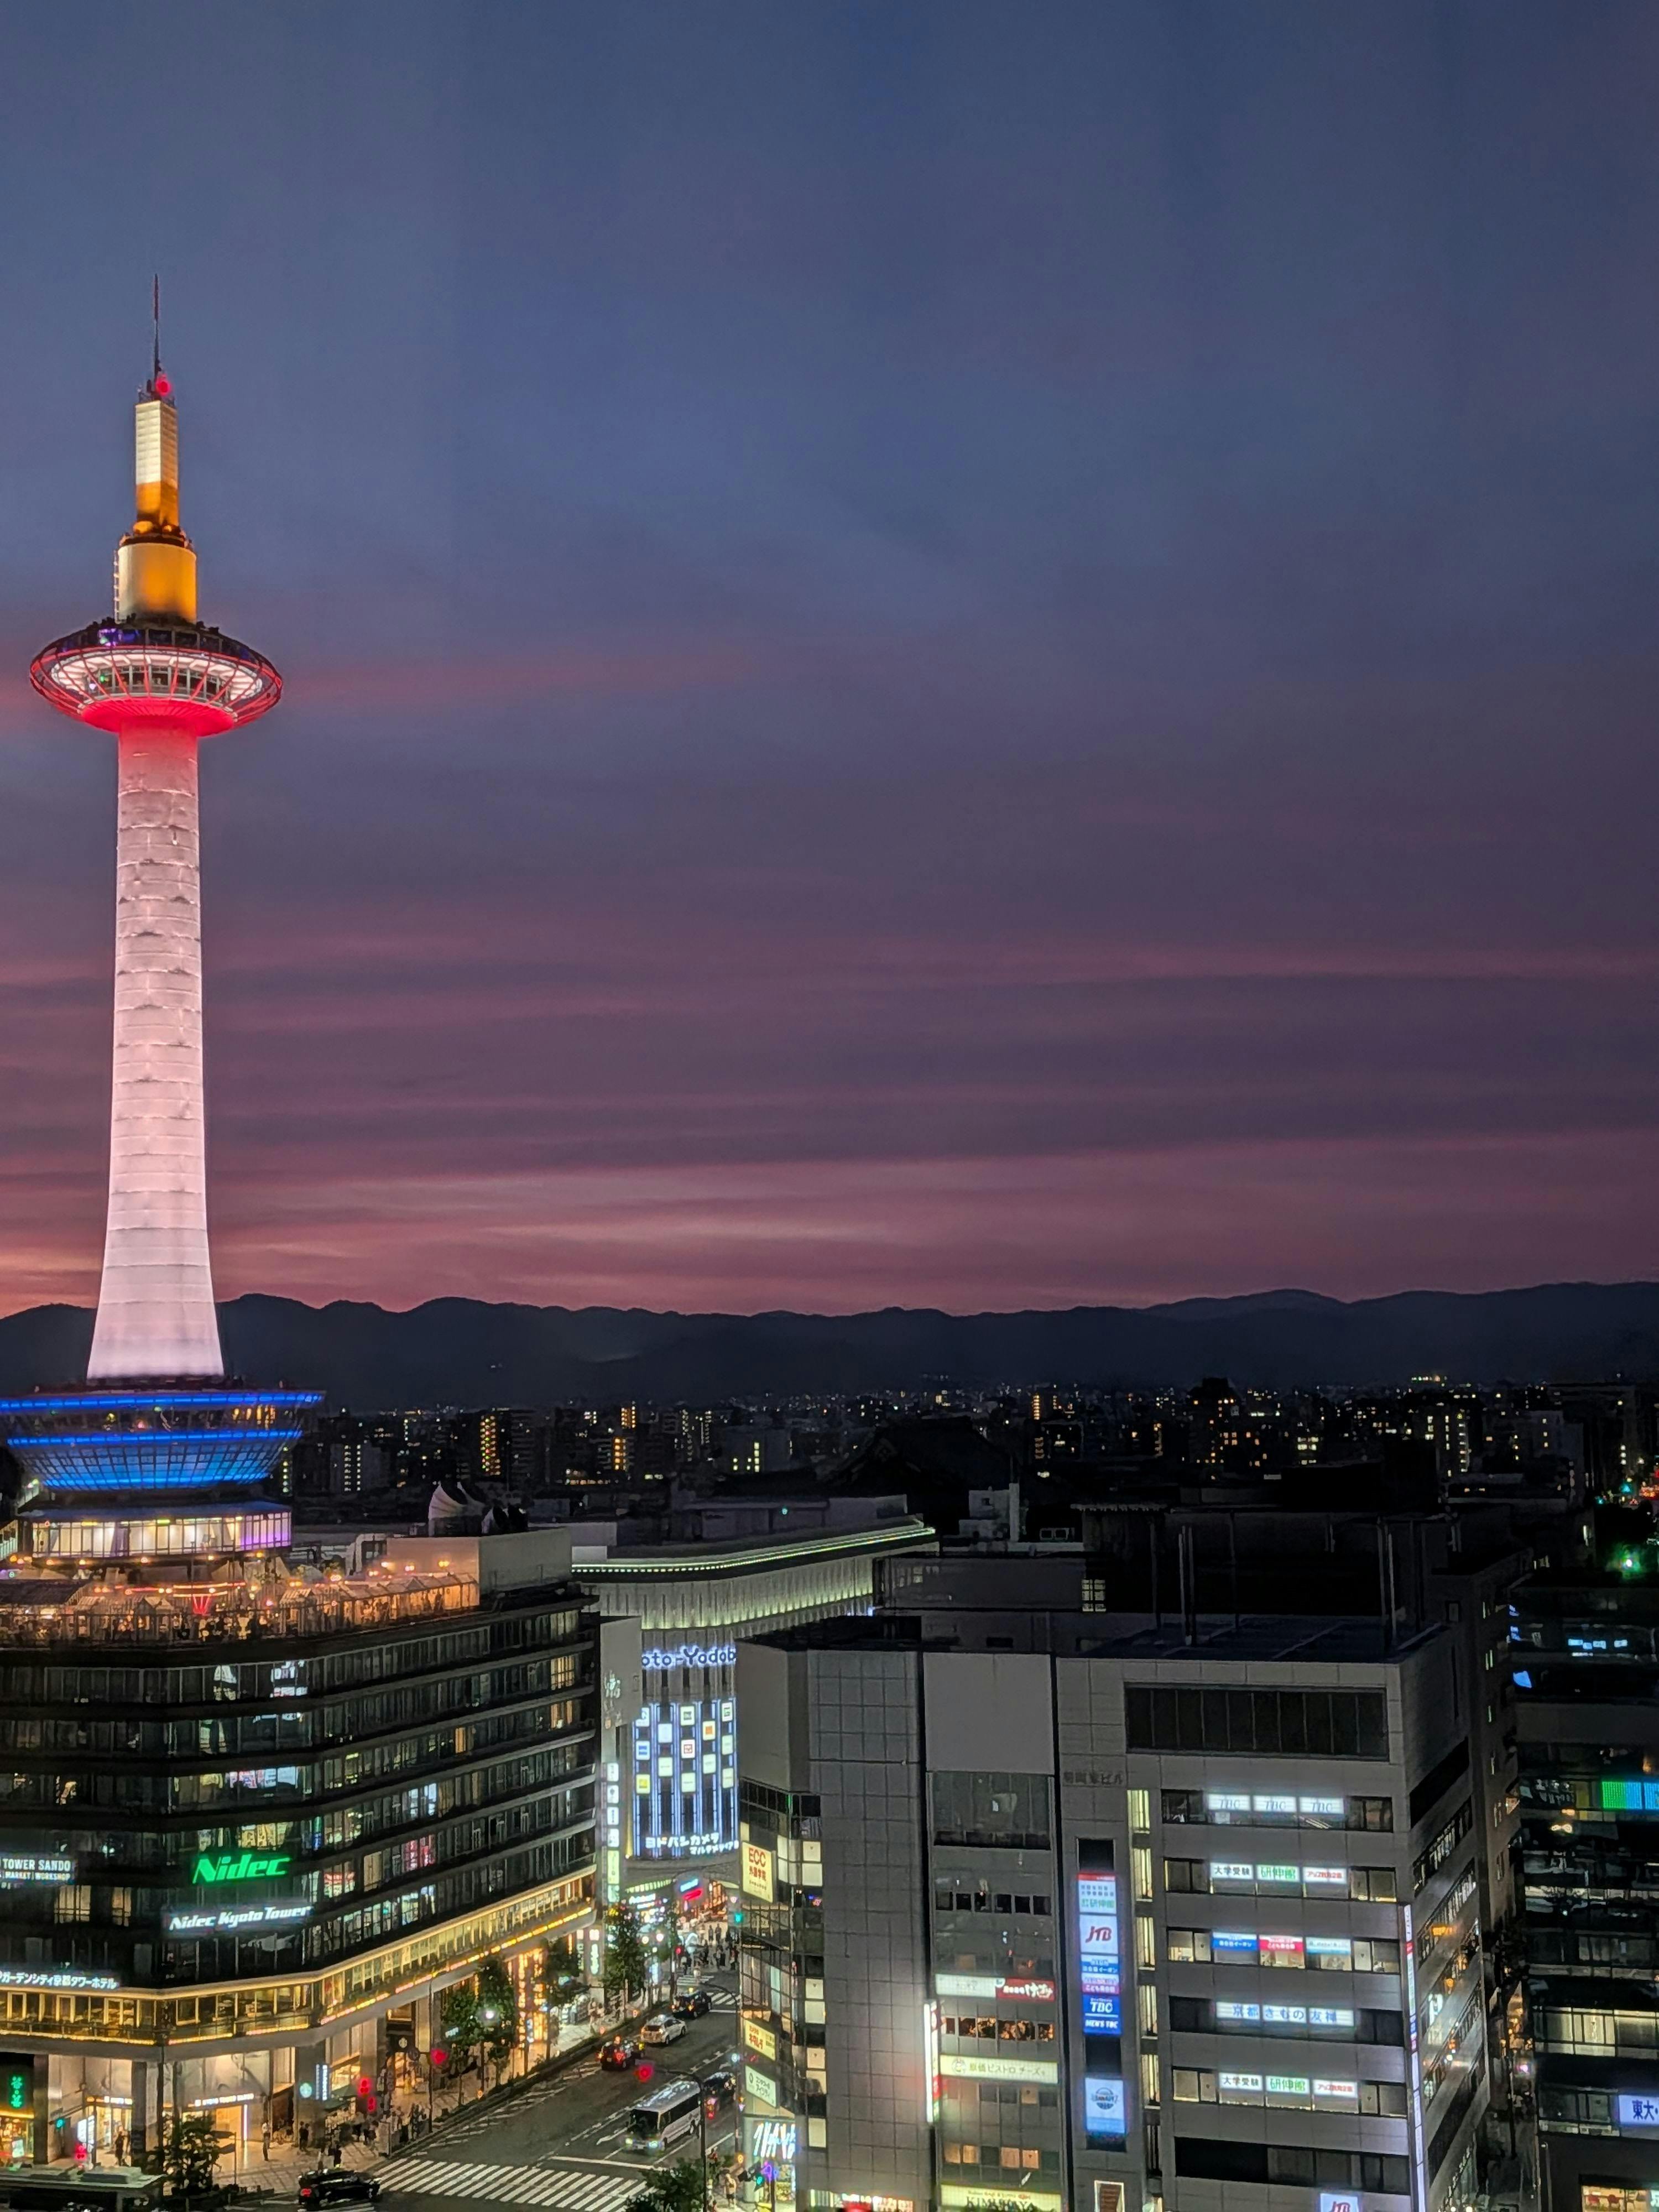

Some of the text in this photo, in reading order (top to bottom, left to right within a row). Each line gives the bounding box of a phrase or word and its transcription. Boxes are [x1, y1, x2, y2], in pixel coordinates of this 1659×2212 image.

[1219, 1798, 1240, 1809] TBC
[1265, 1799, 1286, 1811] TBC
[1311, 1801, 1333, 1812] TBC
[748, 1848, 766, 1867] ECC
[2, 1858, 71, 1872] TOWER SANDO
[192, 1854, 292, 1884] Nidec
[1214, 1865, 1250, 1876] 大学受験
[169, 1906, 312, 1931] Nidec Kyoto Tower
[1085, 1926, 1112, 1943] JTB
[1223, 2076, 1259, 2086] 大学受験
